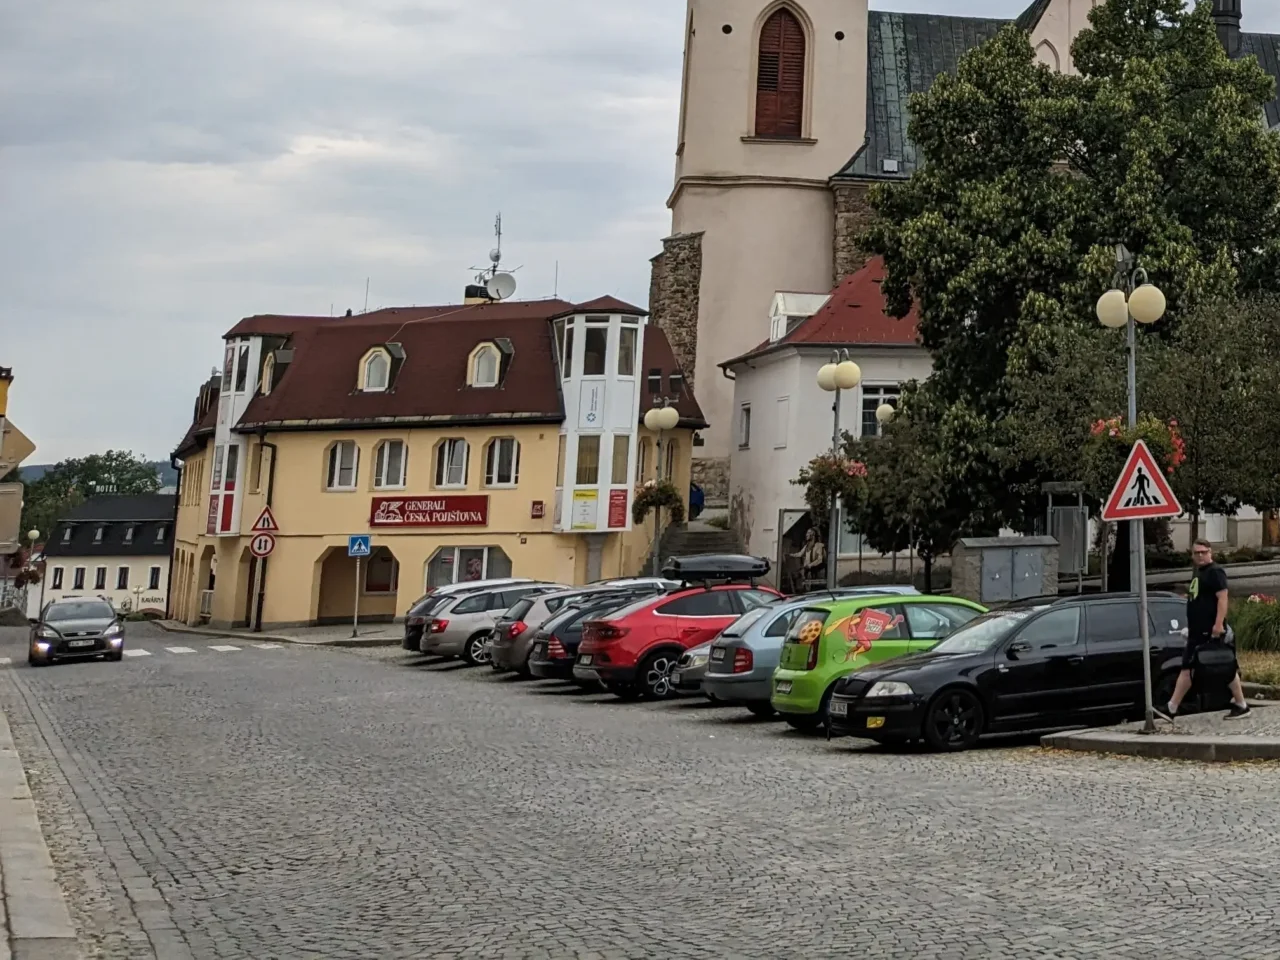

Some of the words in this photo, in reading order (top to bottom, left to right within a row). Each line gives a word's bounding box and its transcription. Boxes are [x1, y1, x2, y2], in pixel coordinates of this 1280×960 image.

[405, 500, 446, 510] GENERALI
[404, 511, 430, 522] ČESKÁ
[432, 509, 482, 522] POJIŠŤOVNA
